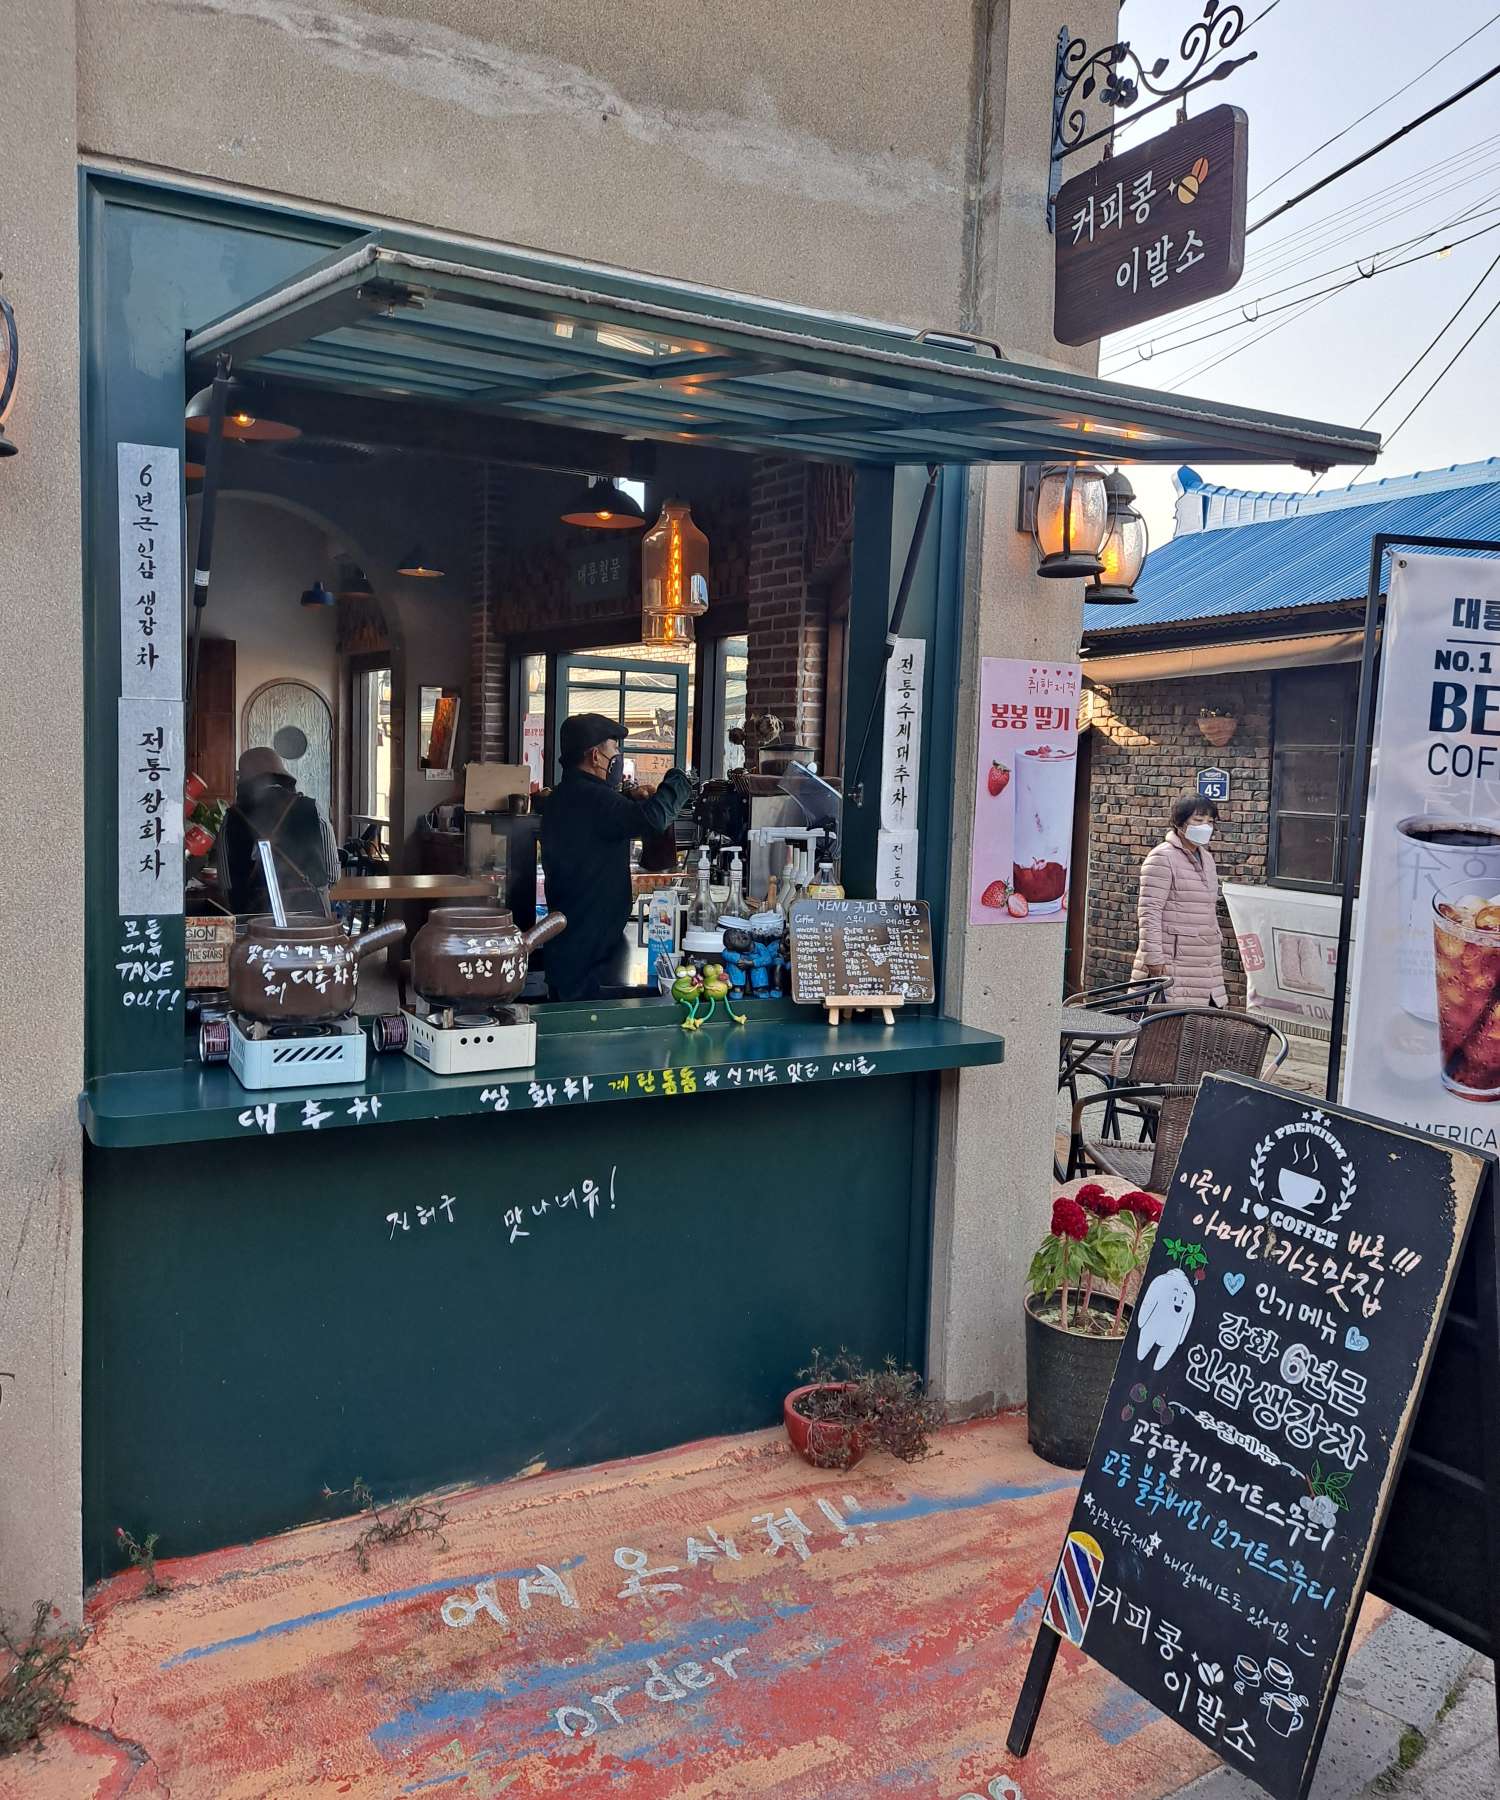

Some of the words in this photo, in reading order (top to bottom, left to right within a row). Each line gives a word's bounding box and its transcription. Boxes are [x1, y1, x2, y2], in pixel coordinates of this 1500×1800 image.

[1071, 170, 1157, 245] 커피콩
[1116, 230, 1205, 294] 이발소
[1434, 650, 1493, 674] NO.1
[991, 703, 1028, 730] 봉봉
[1034, 706, 1070, 731] 딸기
[1204, 784, 1221, 797] 45
[124, 919, 162, 940] 모든
[116, 960, 175, 982] TAKE
[123, 989, 180, 1011] OUT!
[1274, 1122, 1347, 1160] PREMIUM
[1400, 1121, 1498, 1150] ERICA
[1179, 1169, 1232, 1205] 이곳이
[1240, 1197, 1251, 1215] I
[1270, 1211, 1339, 1249] COFFEE
[1255, 1283, 1293, 1320] 인기
[1298, 1303, 1338, 1345] 메뉴
[1218, 1312, 1280, 1364] 강화
[1095, 1584, 1183, 1660] 커피콩
[552, 1647, 750, 1738] order
[1163, 1671, 1257, 1762] 이발소
